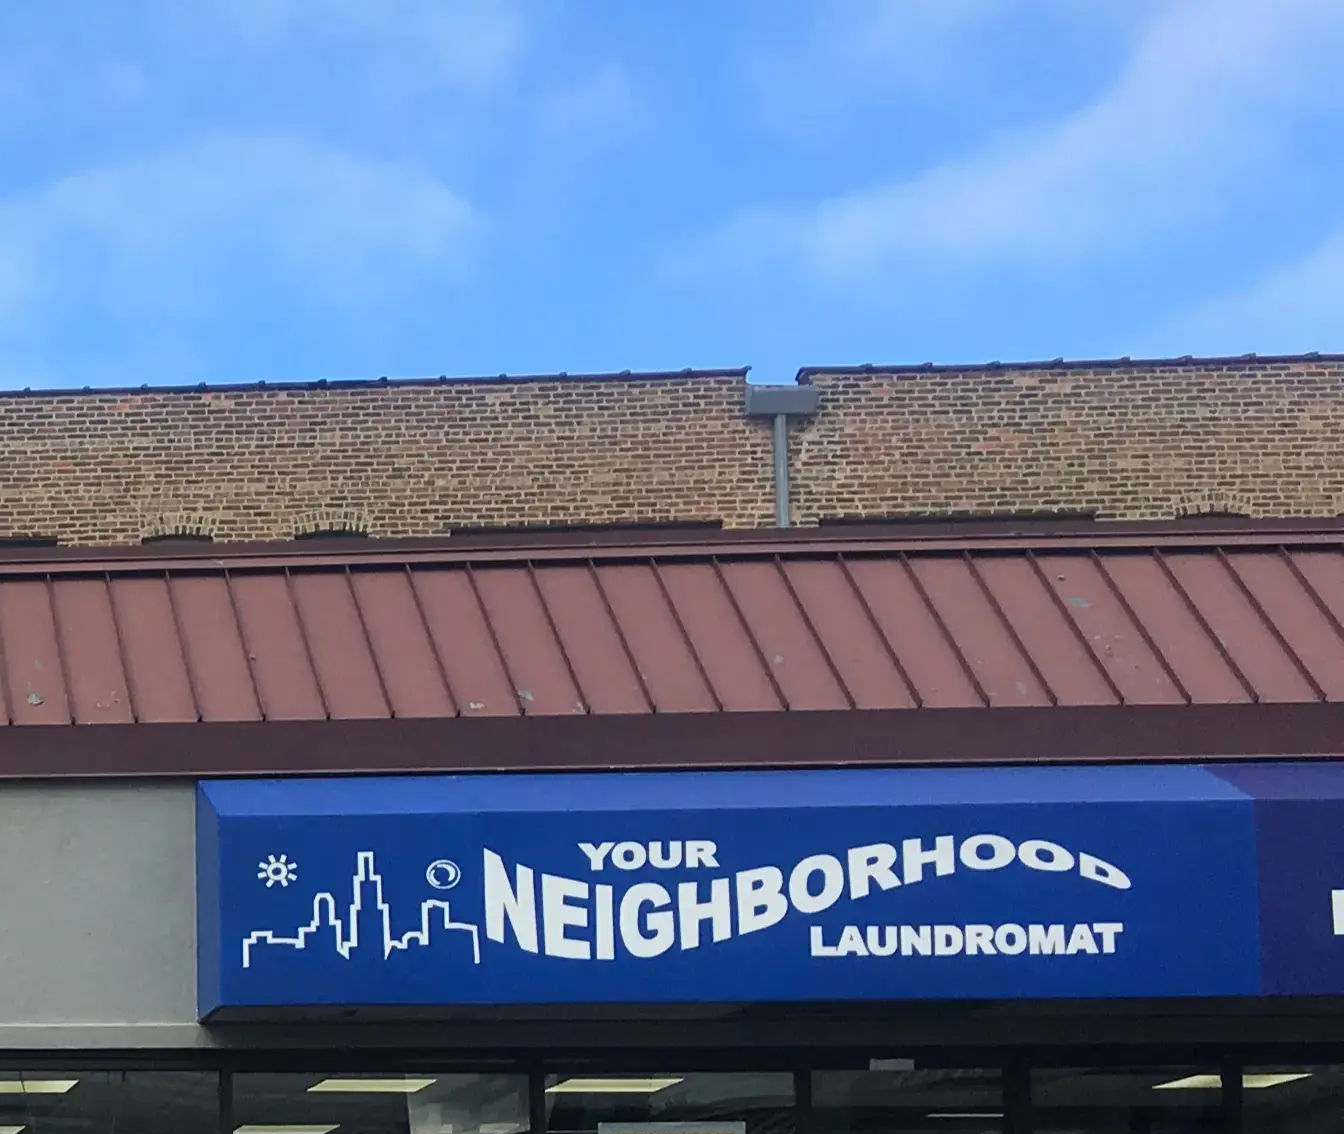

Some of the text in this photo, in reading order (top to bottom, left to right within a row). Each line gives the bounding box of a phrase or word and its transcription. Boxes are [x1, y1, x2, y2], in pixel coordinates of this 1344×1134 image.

[578, 840, 719, 870] YOUR
[484, 834, 1131, 961] NEIGHBORHOOD
[810, 923, 1123, 957] LAUNDROMAT
